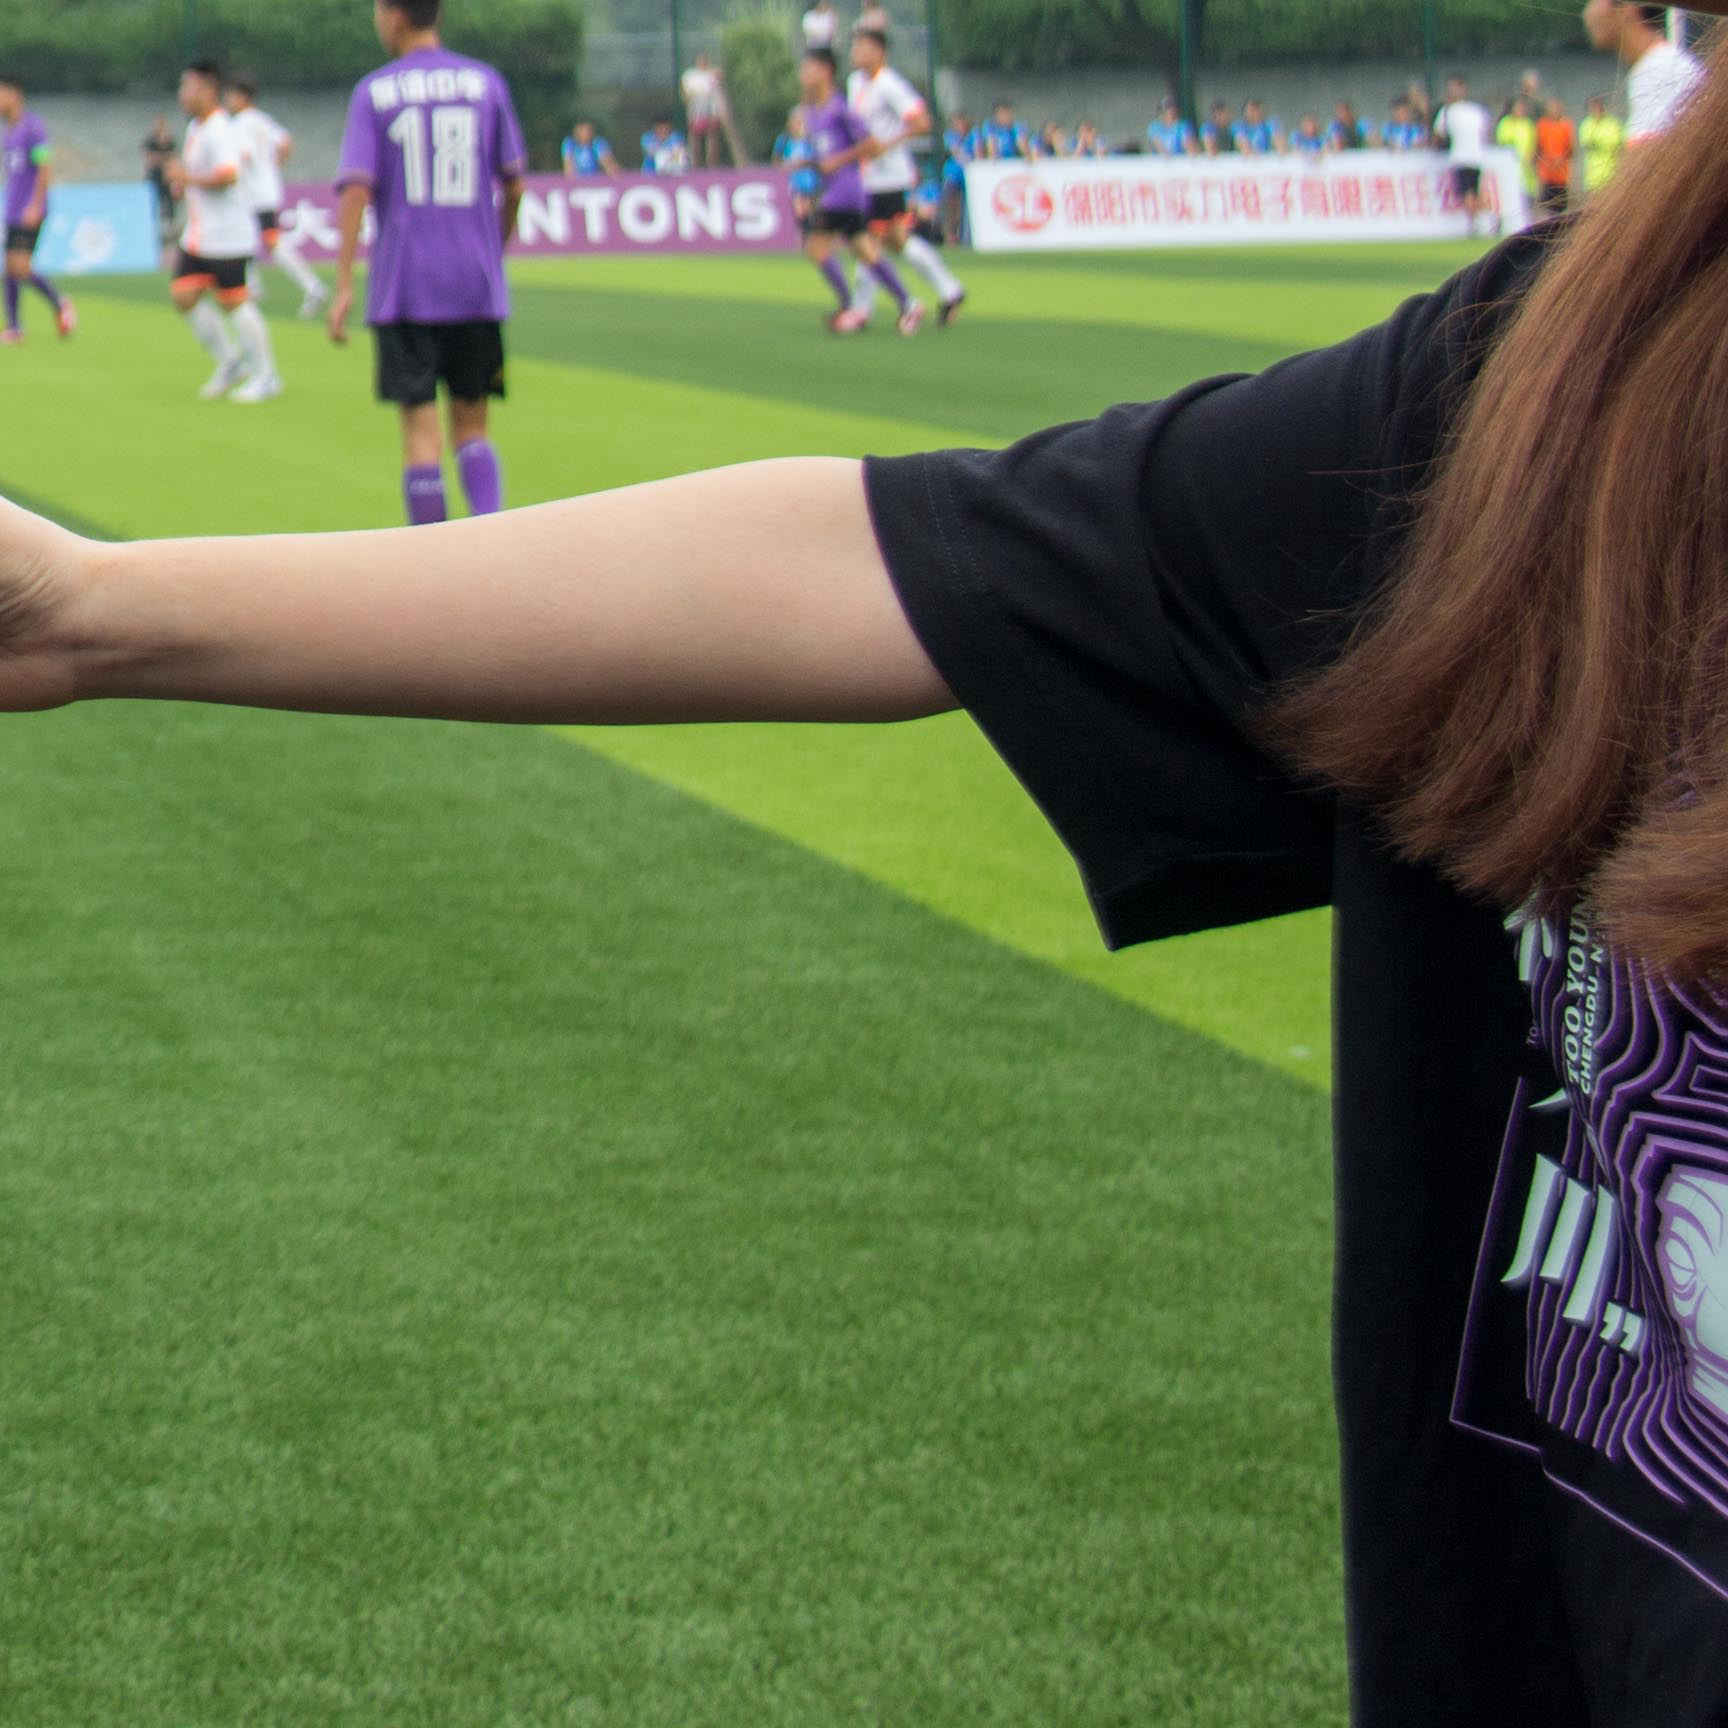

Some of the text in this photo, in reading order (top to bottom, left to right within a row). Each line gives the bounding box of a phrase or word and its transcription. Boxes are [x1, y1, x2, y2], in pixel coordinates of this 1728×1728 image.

[388, 105, 478, 206] 18
[493, 178, 780, 245] NTONS
[1563, 1006, 1583, 1084] TOO
[1579, 975, 1599, 1095] CHENGDU
